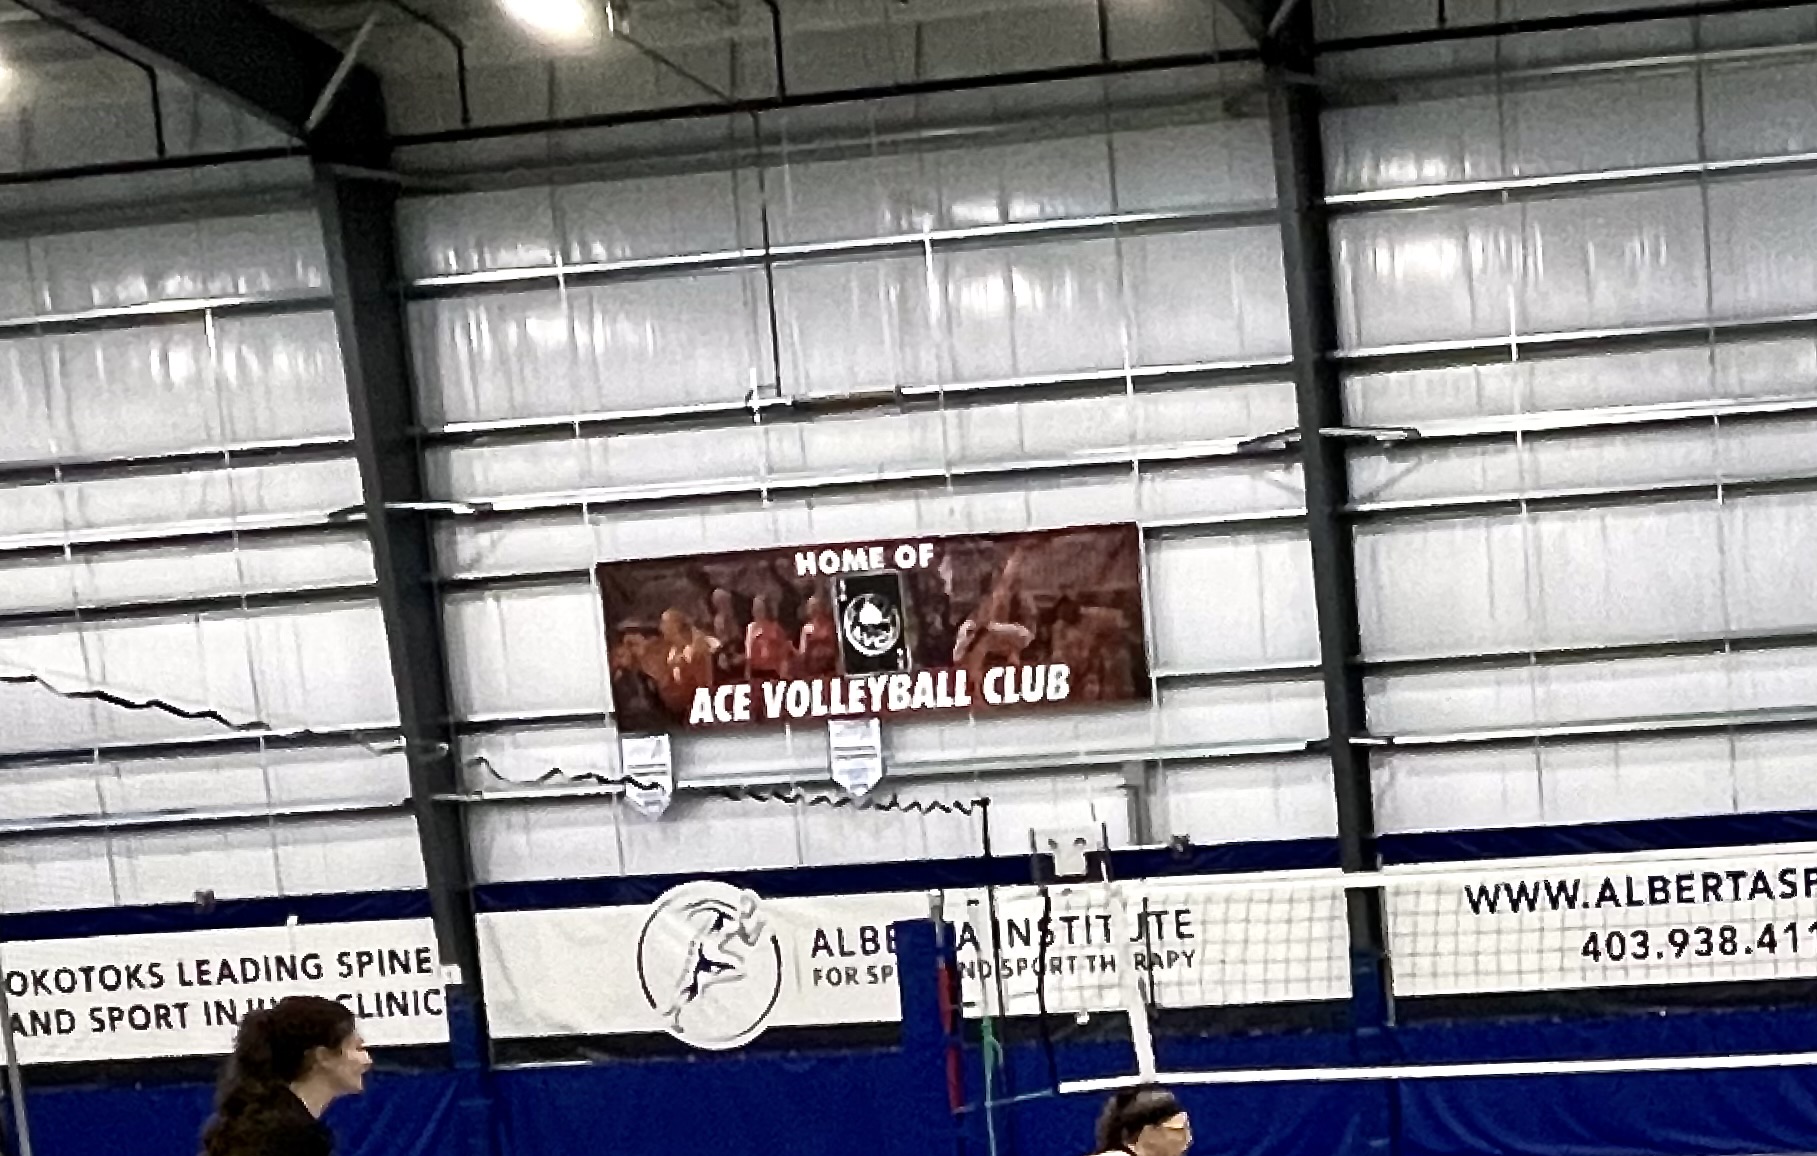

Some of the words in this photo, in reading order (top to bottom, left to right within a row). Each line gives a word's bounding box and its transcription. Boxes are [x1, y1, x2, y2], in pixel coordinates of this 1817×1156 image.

[794, 547, 886, 576] HOME
[894, 543, 934, 568] OF
[689, 683, 751, 724] ACE
[761, 669, 972, 719] VOLLEYBALL
[982, 663, 1071, 705] CLUB
[810, 921, 983, 958] ALBEA
[6, 962, 166, 997] OKOTOKS
[177, 952, 324, 987] LEADING
[336, 946, 433, 979] SPINE
[812, 965, 860, 987] FOR
[1084, 948, 1196, 975] THRAPY
[10, 1008, 76, 1037] AND
[88, 1001, 189, 1033] SPORT
